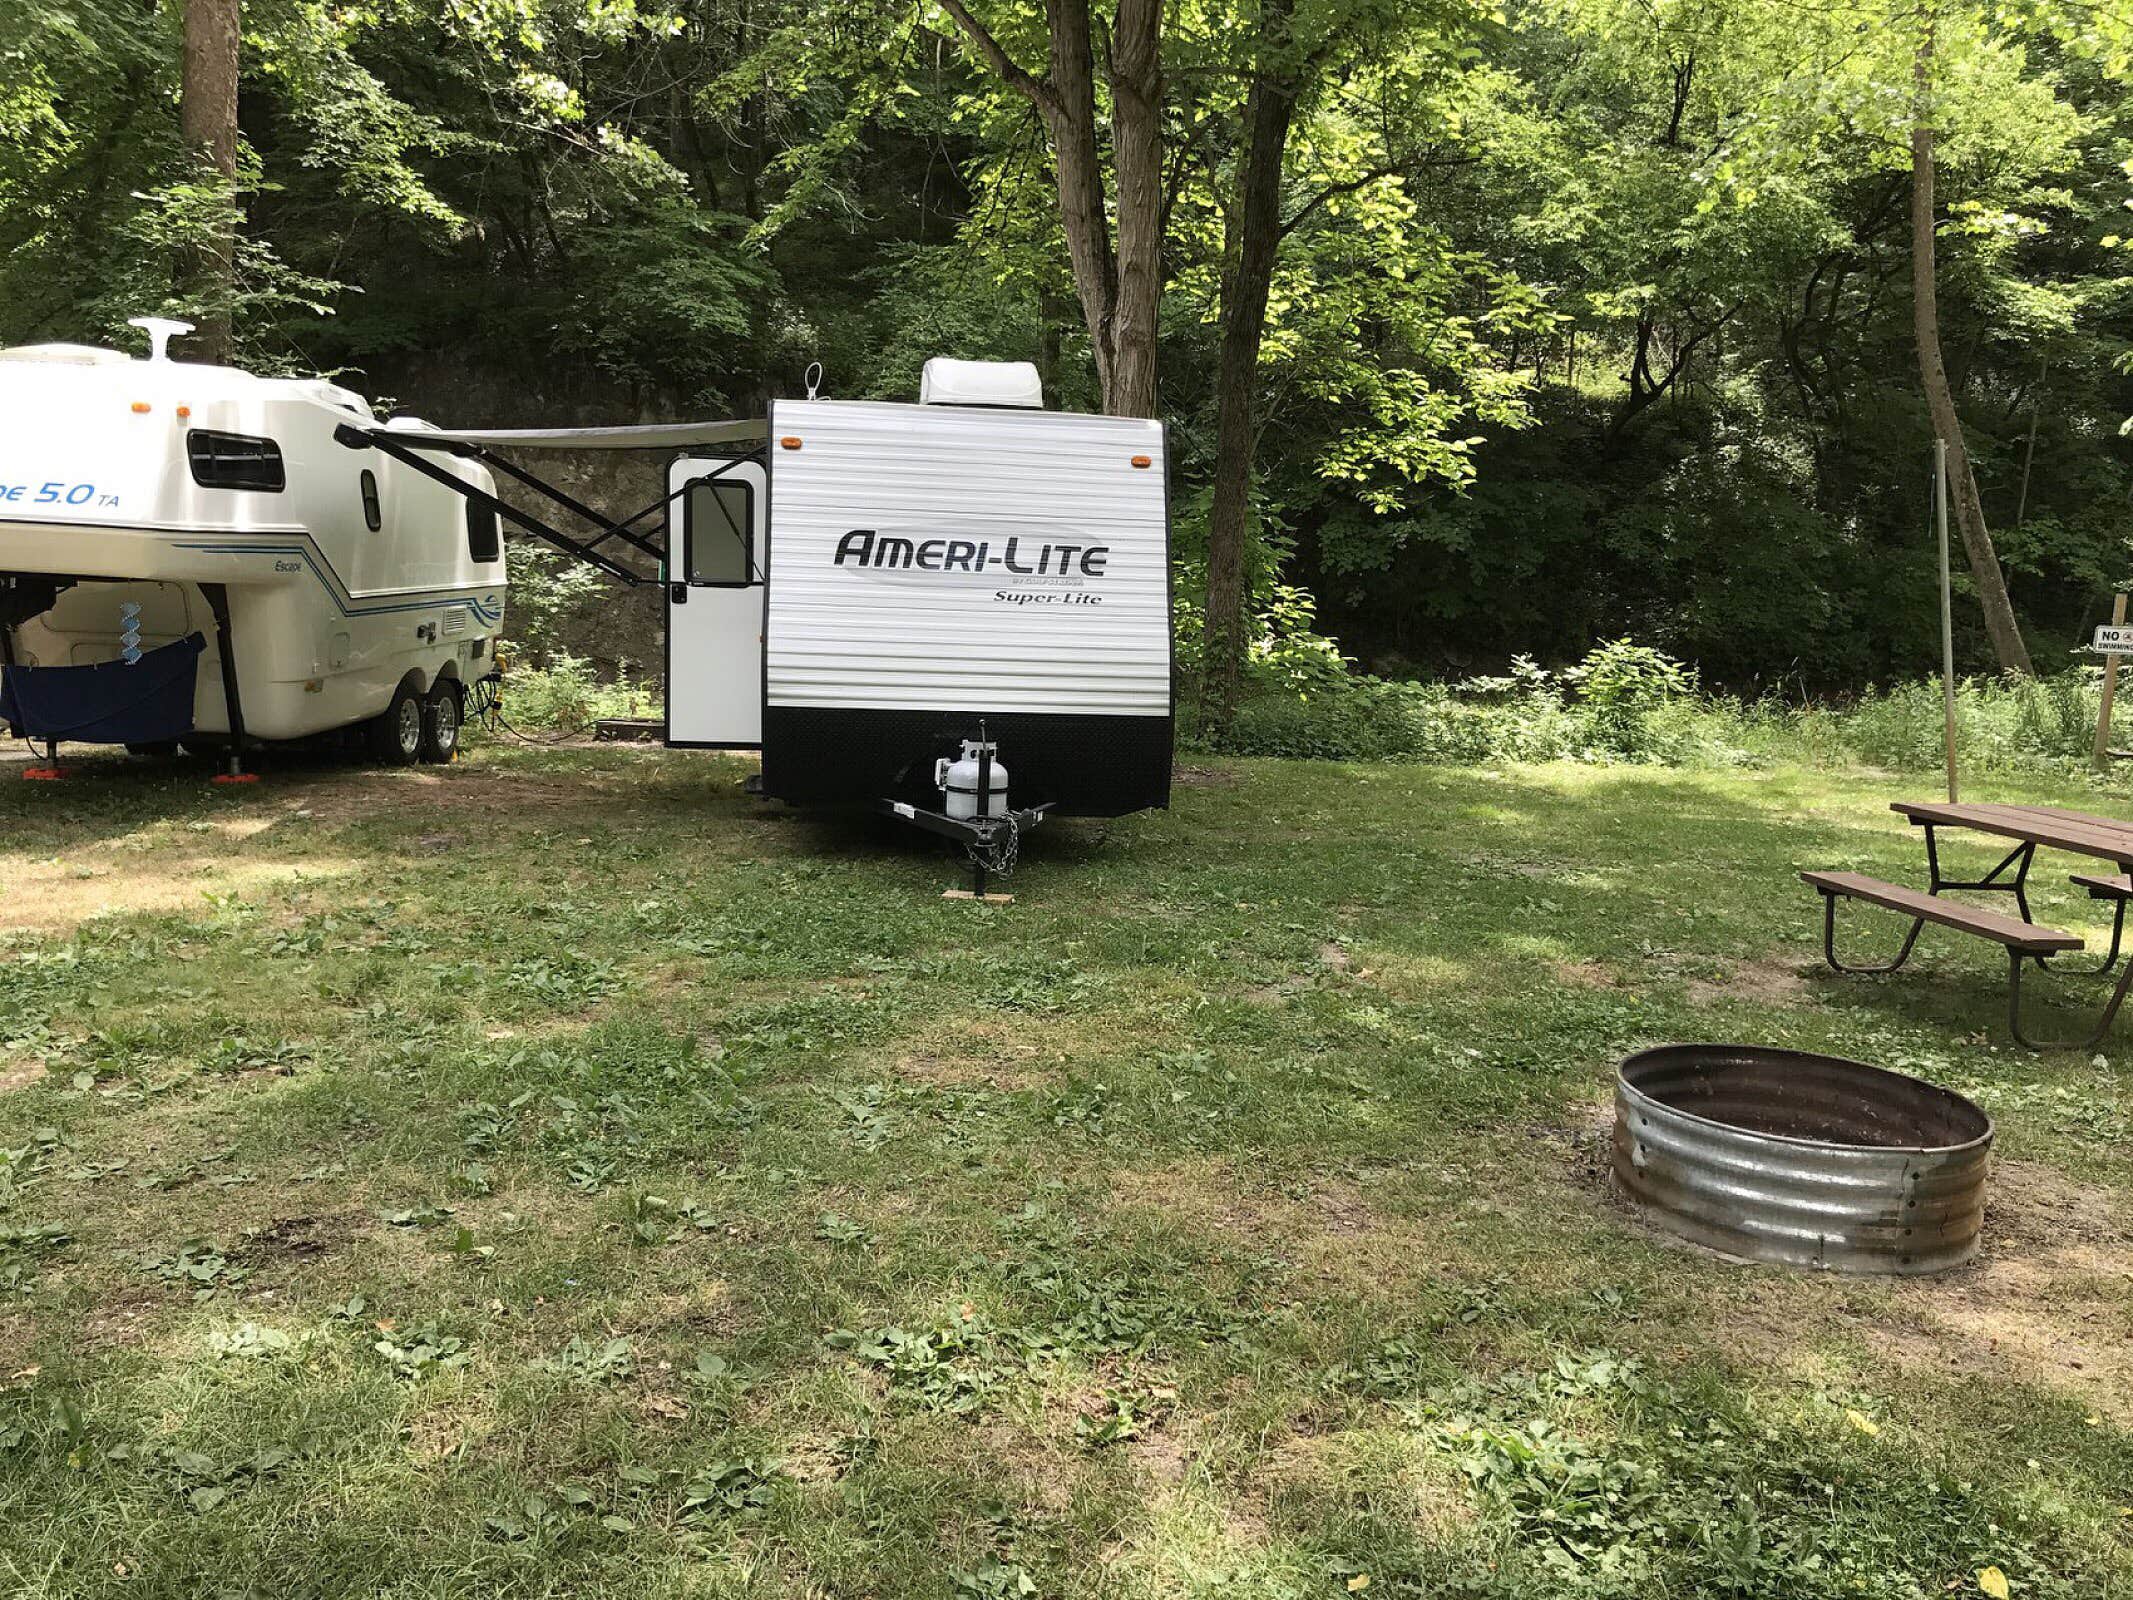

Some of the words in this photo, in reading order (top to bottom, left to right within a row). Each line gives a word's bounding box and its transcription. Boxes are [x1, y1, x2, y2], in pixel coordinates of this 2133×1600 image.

[33, 482, 95, 505] 5.0
[98, 495, 119, 507] TA
[993, 590, 1102, 605] Super-Lite
[2102, 631, 2120, 641] NO
